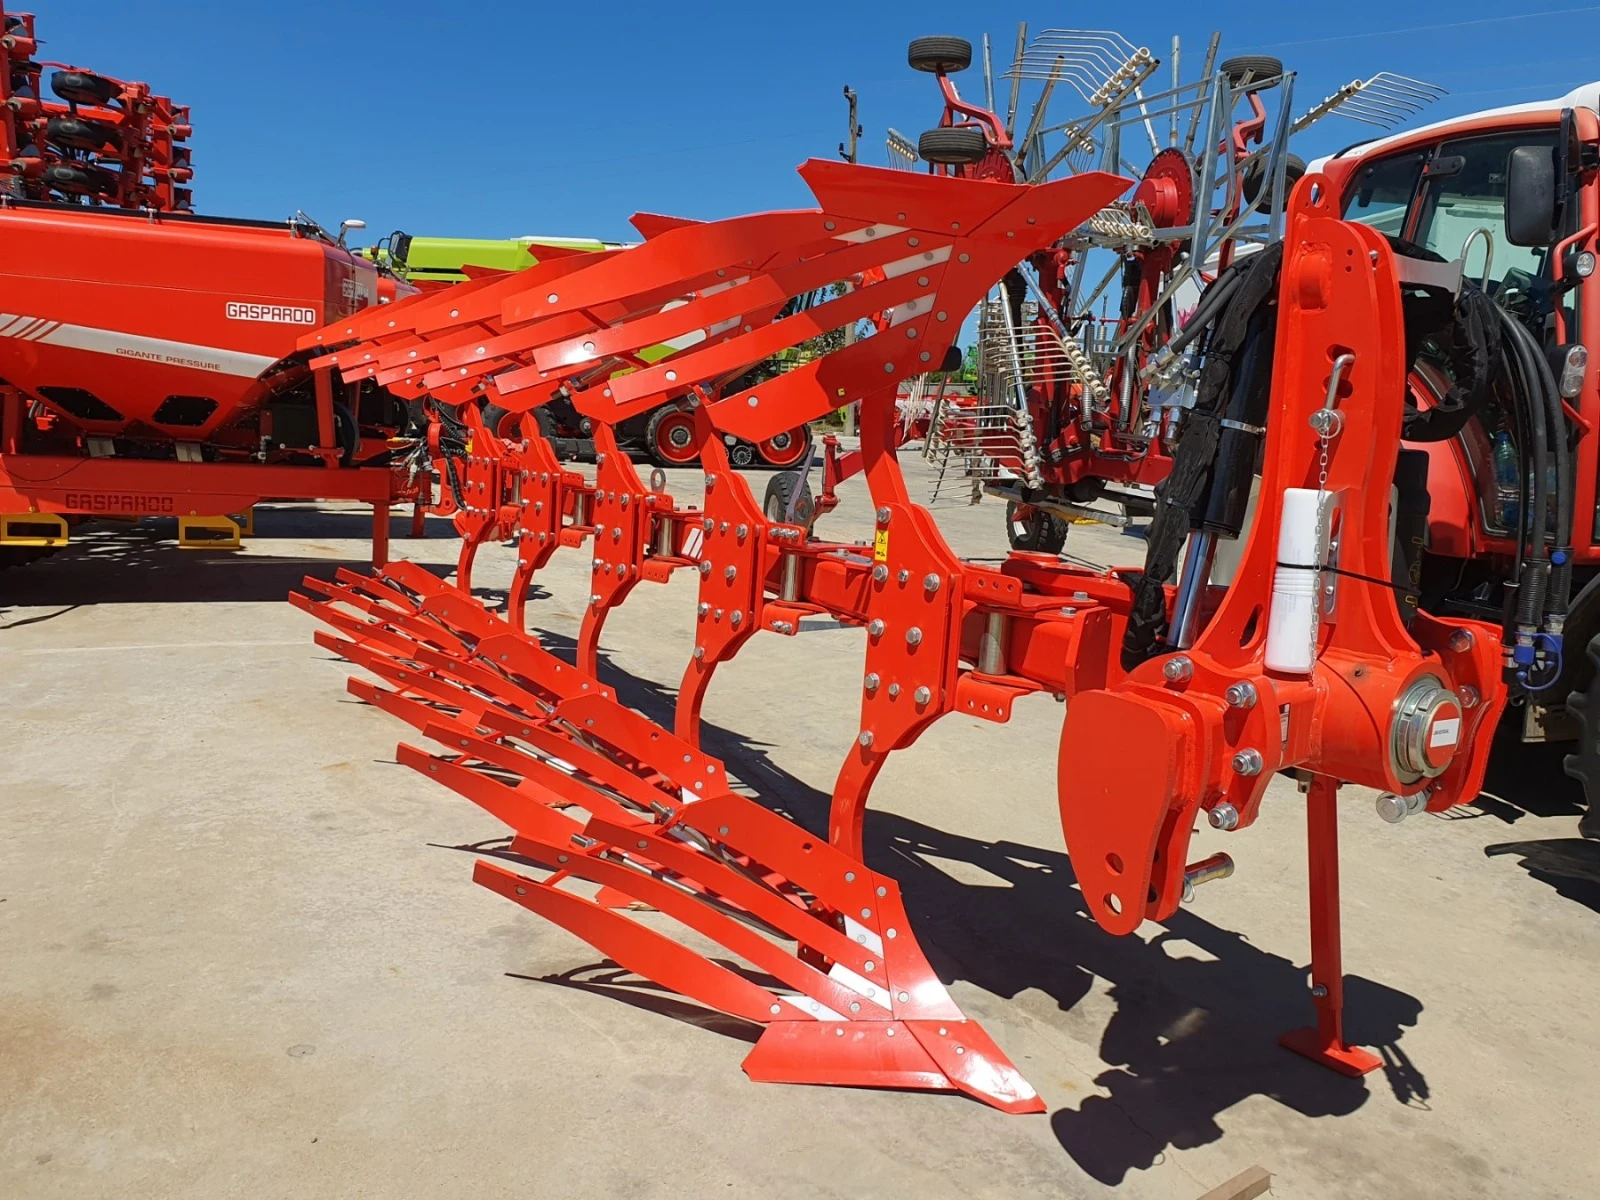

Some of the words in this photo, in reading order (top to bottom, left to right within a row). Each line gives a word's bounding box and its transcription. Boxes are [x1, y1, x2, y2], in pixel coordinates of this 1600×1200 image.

[228, 303, 314, 323] GASPARDO
[116, 347, 162, 360] GIGANTE
[166, 356, 221, 370] PRESSURE
[65, 493, 174, 512] GASPARDO
